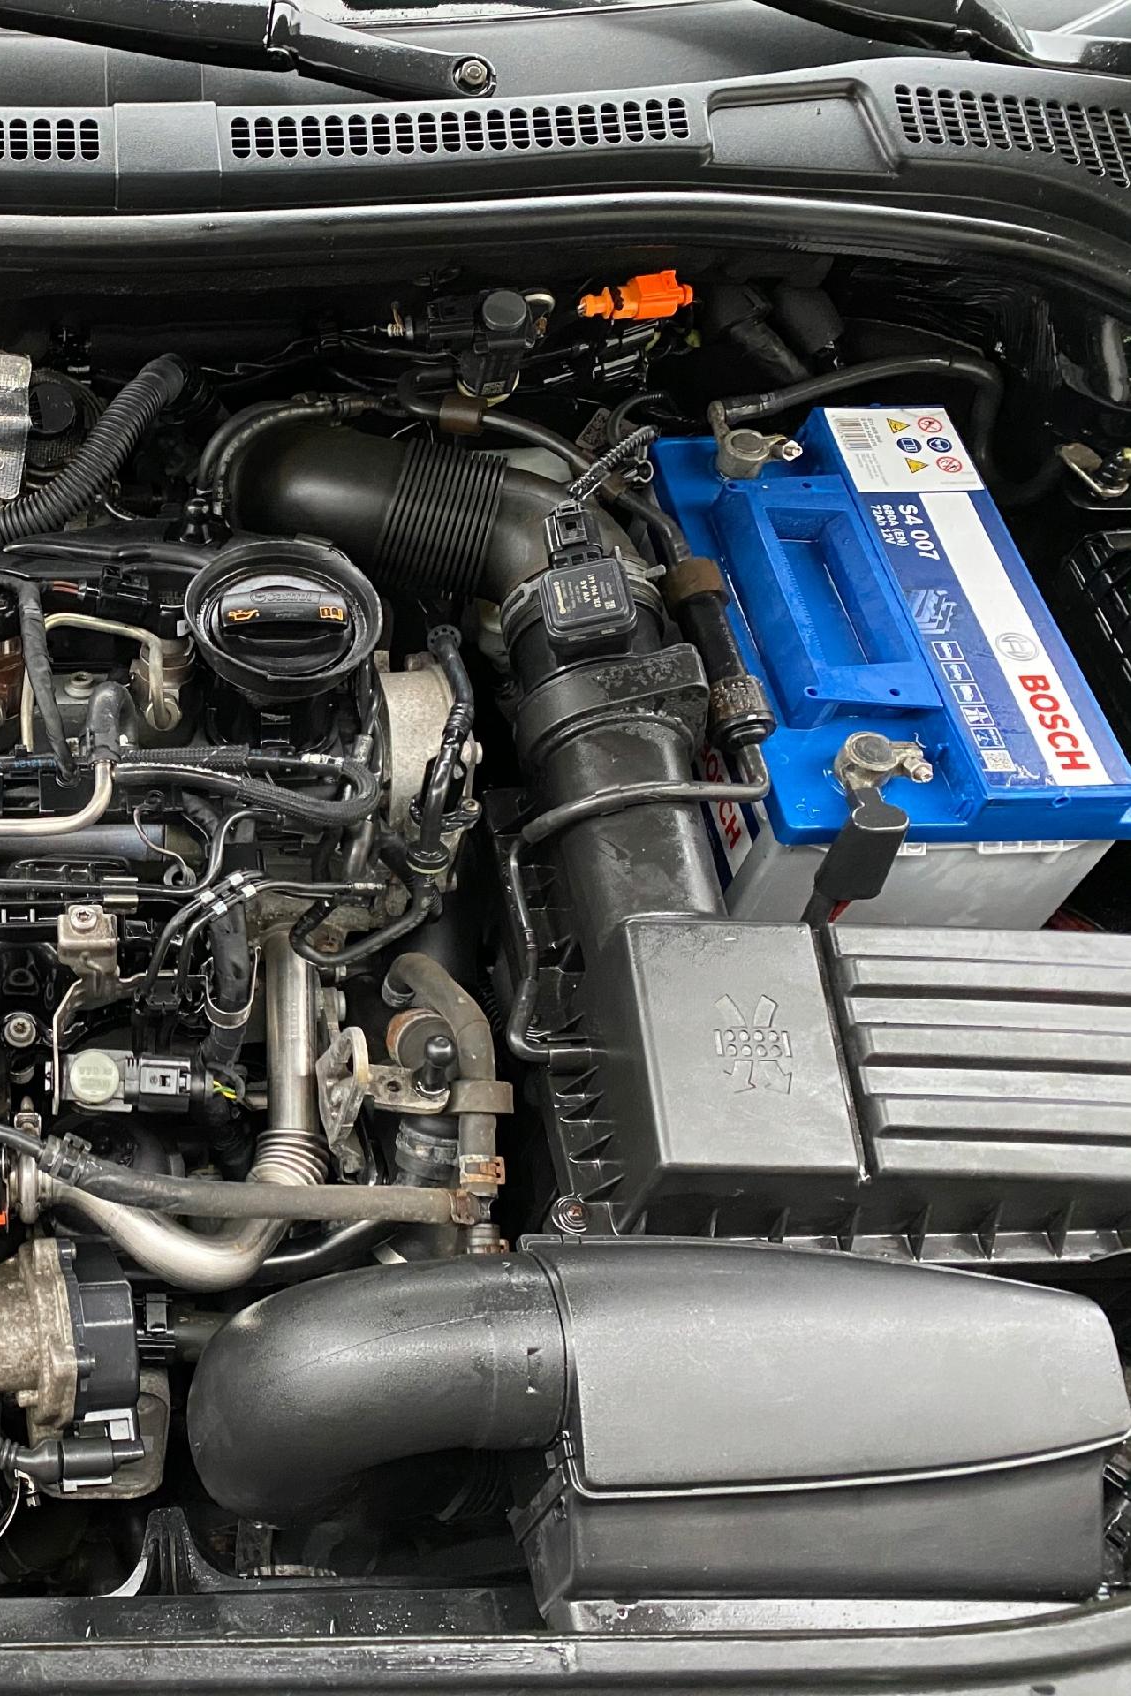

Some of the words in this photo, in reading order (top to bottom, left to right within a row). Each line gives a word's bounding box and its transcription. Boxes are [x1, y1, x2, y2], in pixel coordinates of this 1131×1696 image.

[870, 505, 887, 527] 72Ah
[880, 528, 897, 545] 12V
[882, 504, 900, 527] 680A
[893, 528, 910, 547] (EN)
[898, 504, 923, 526] S4
[911, 529, 940, 561] 007
[1018, 674, 1091, 770] BOSCH
